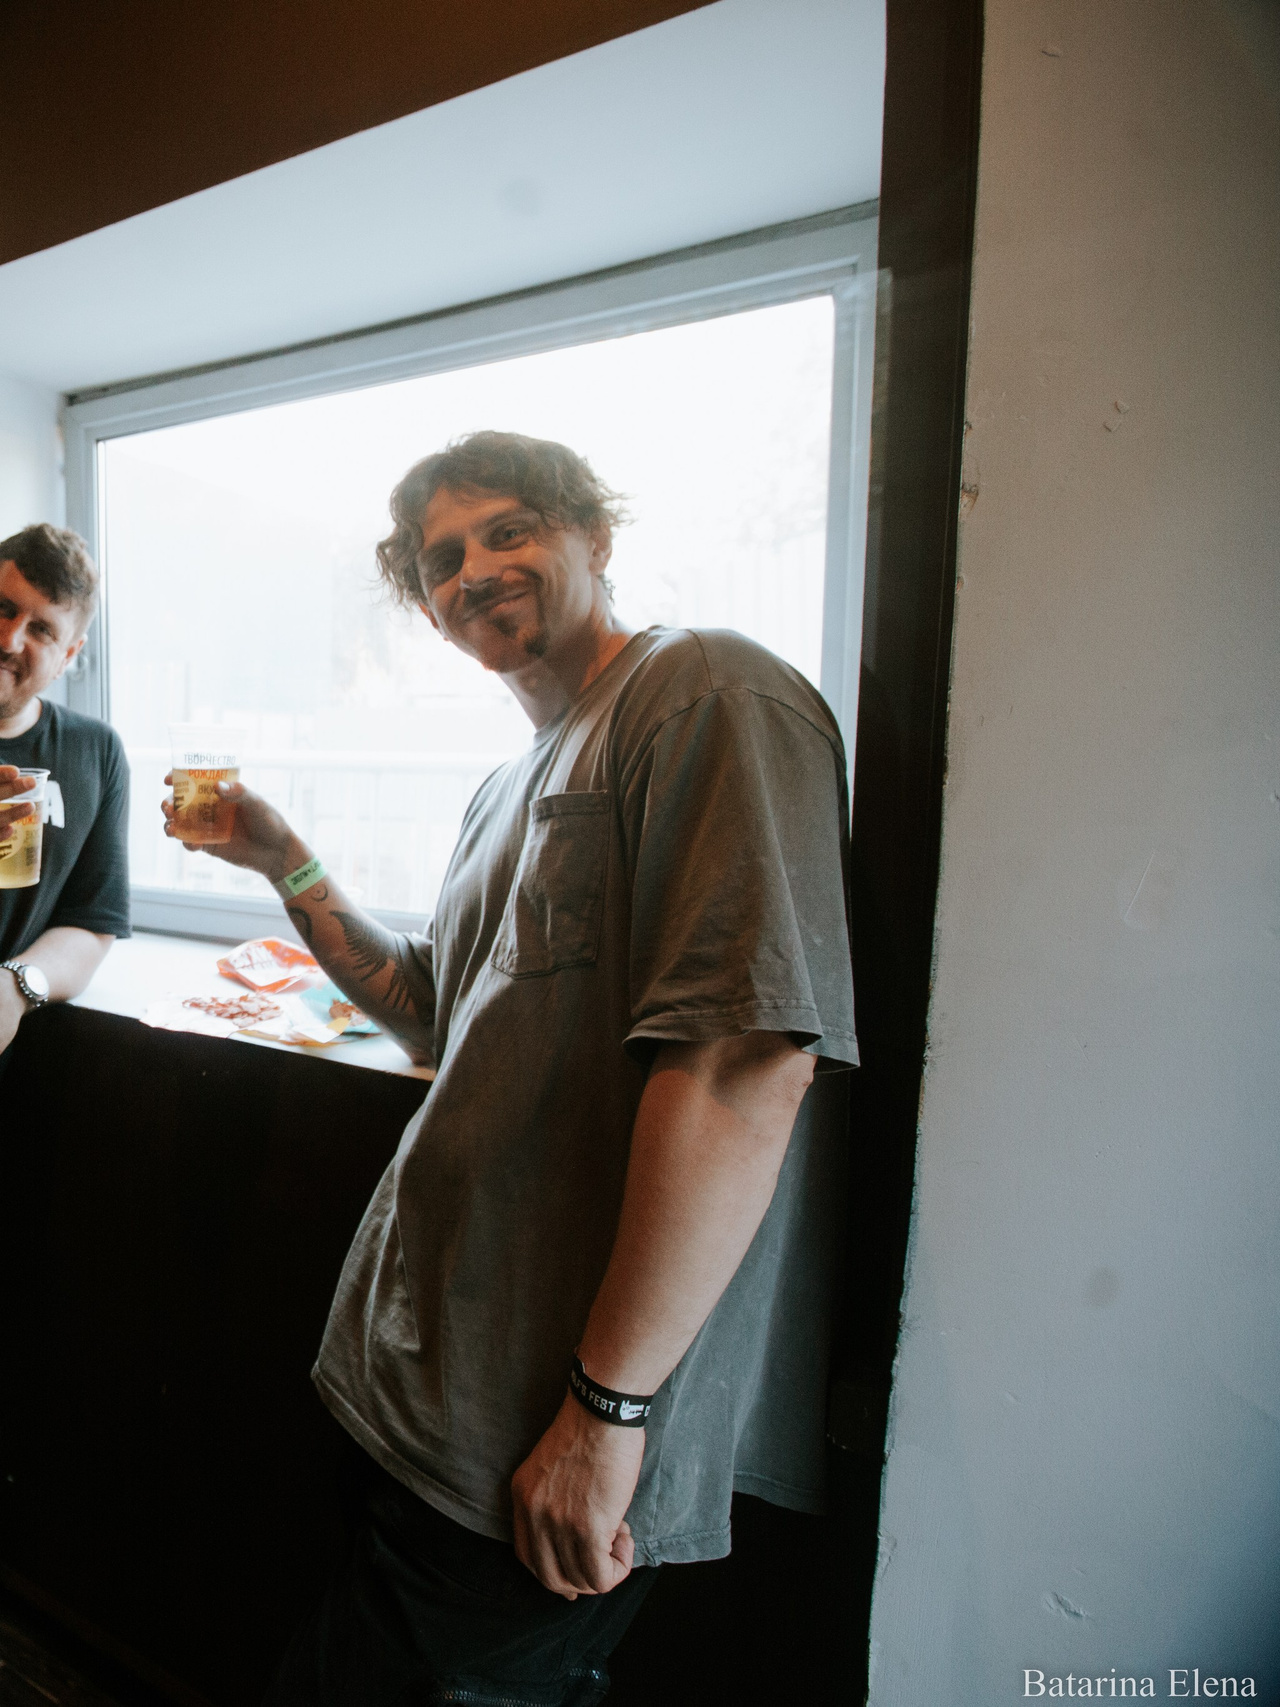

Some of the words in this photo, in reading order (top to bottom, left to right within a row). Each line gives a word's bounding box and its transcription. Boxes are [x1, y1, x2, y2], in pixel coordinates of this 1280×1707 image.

[183, 753, 237, 766] ТВОРЧЕСТВО
[188, 769, 229, 780] РОЖДАЕТ
[198, 784, 216, 795] ВКУ
[588, 1391, 616, 1413] FEST
